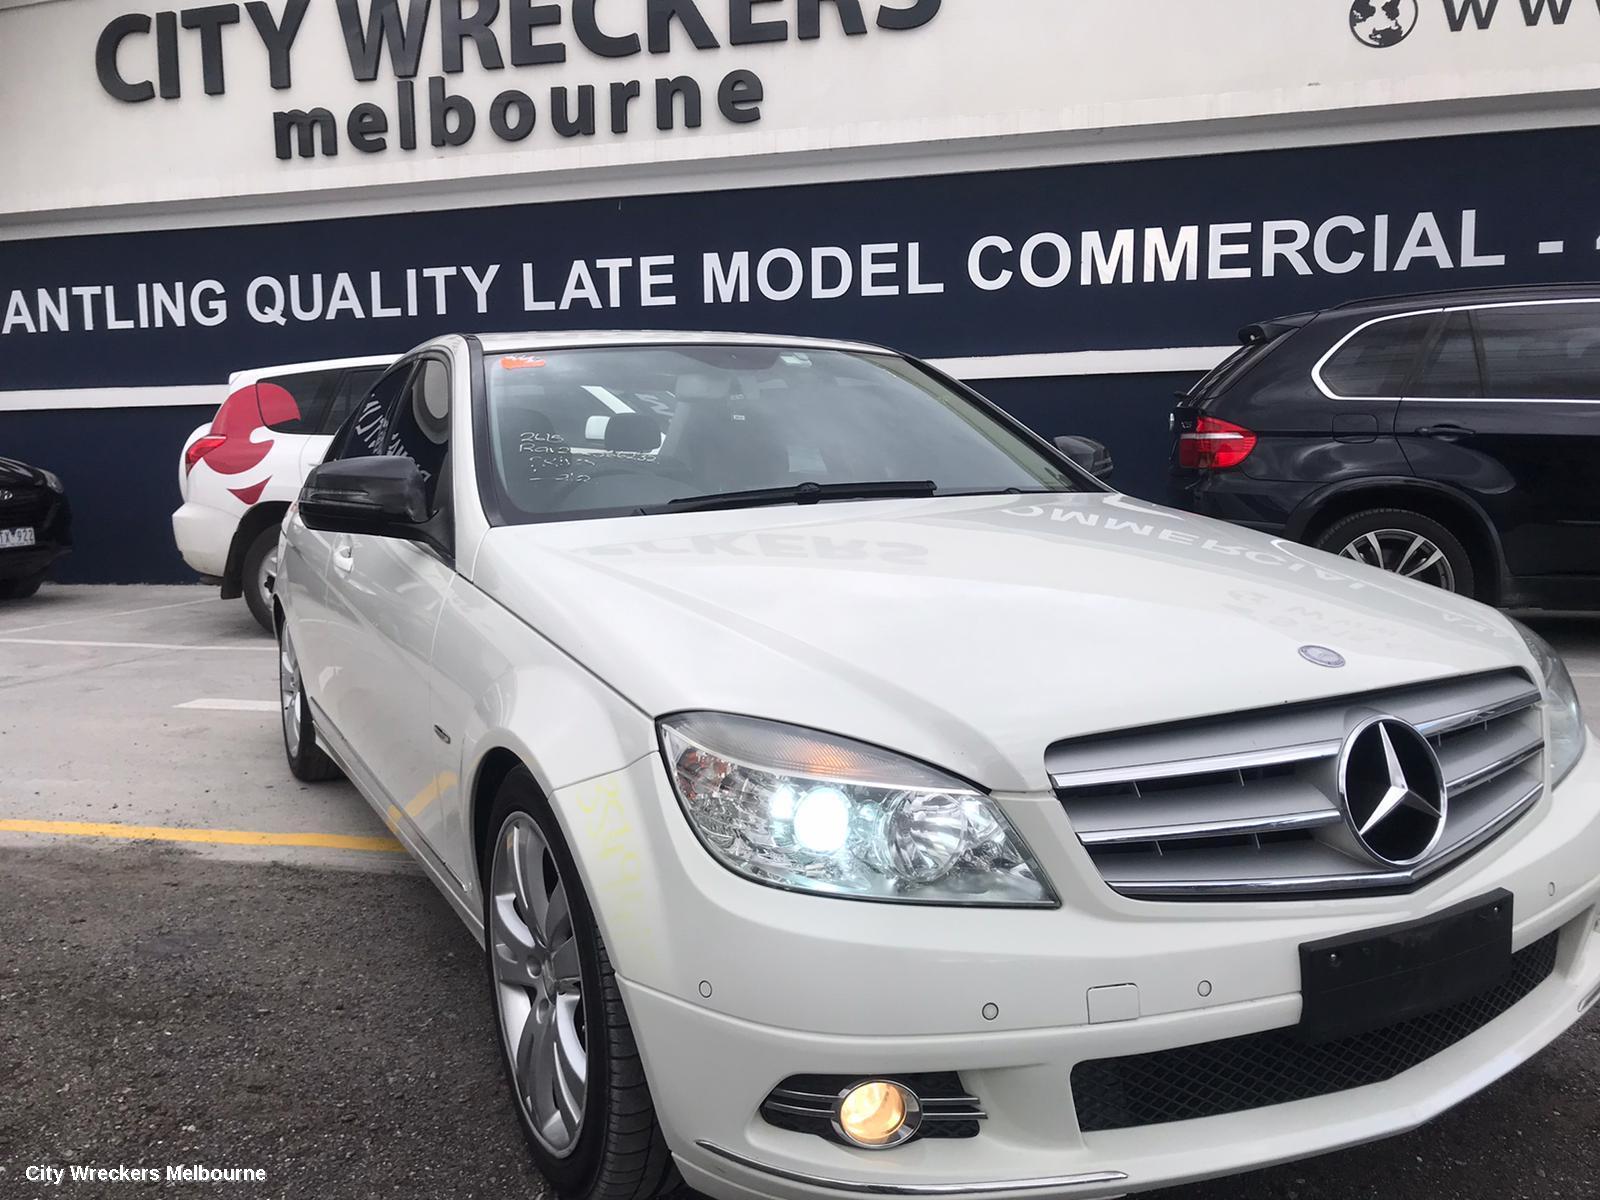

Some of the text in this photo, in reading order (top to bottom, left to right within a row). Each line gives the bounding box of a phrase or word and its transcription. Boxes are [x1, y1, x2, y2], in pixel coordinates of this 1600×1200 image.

[95, 0, 311, 102] CITY
[273, 67, 764, 160] melbourne
[1, 280, 228, 334] ANTLING
[246, 264, 501, 326] QUALITY
[522, 254, 677, 311] LATE
[702, 241, 945, 303] MODEL
[967, 209, 1506, 291] COMMERCIAL
